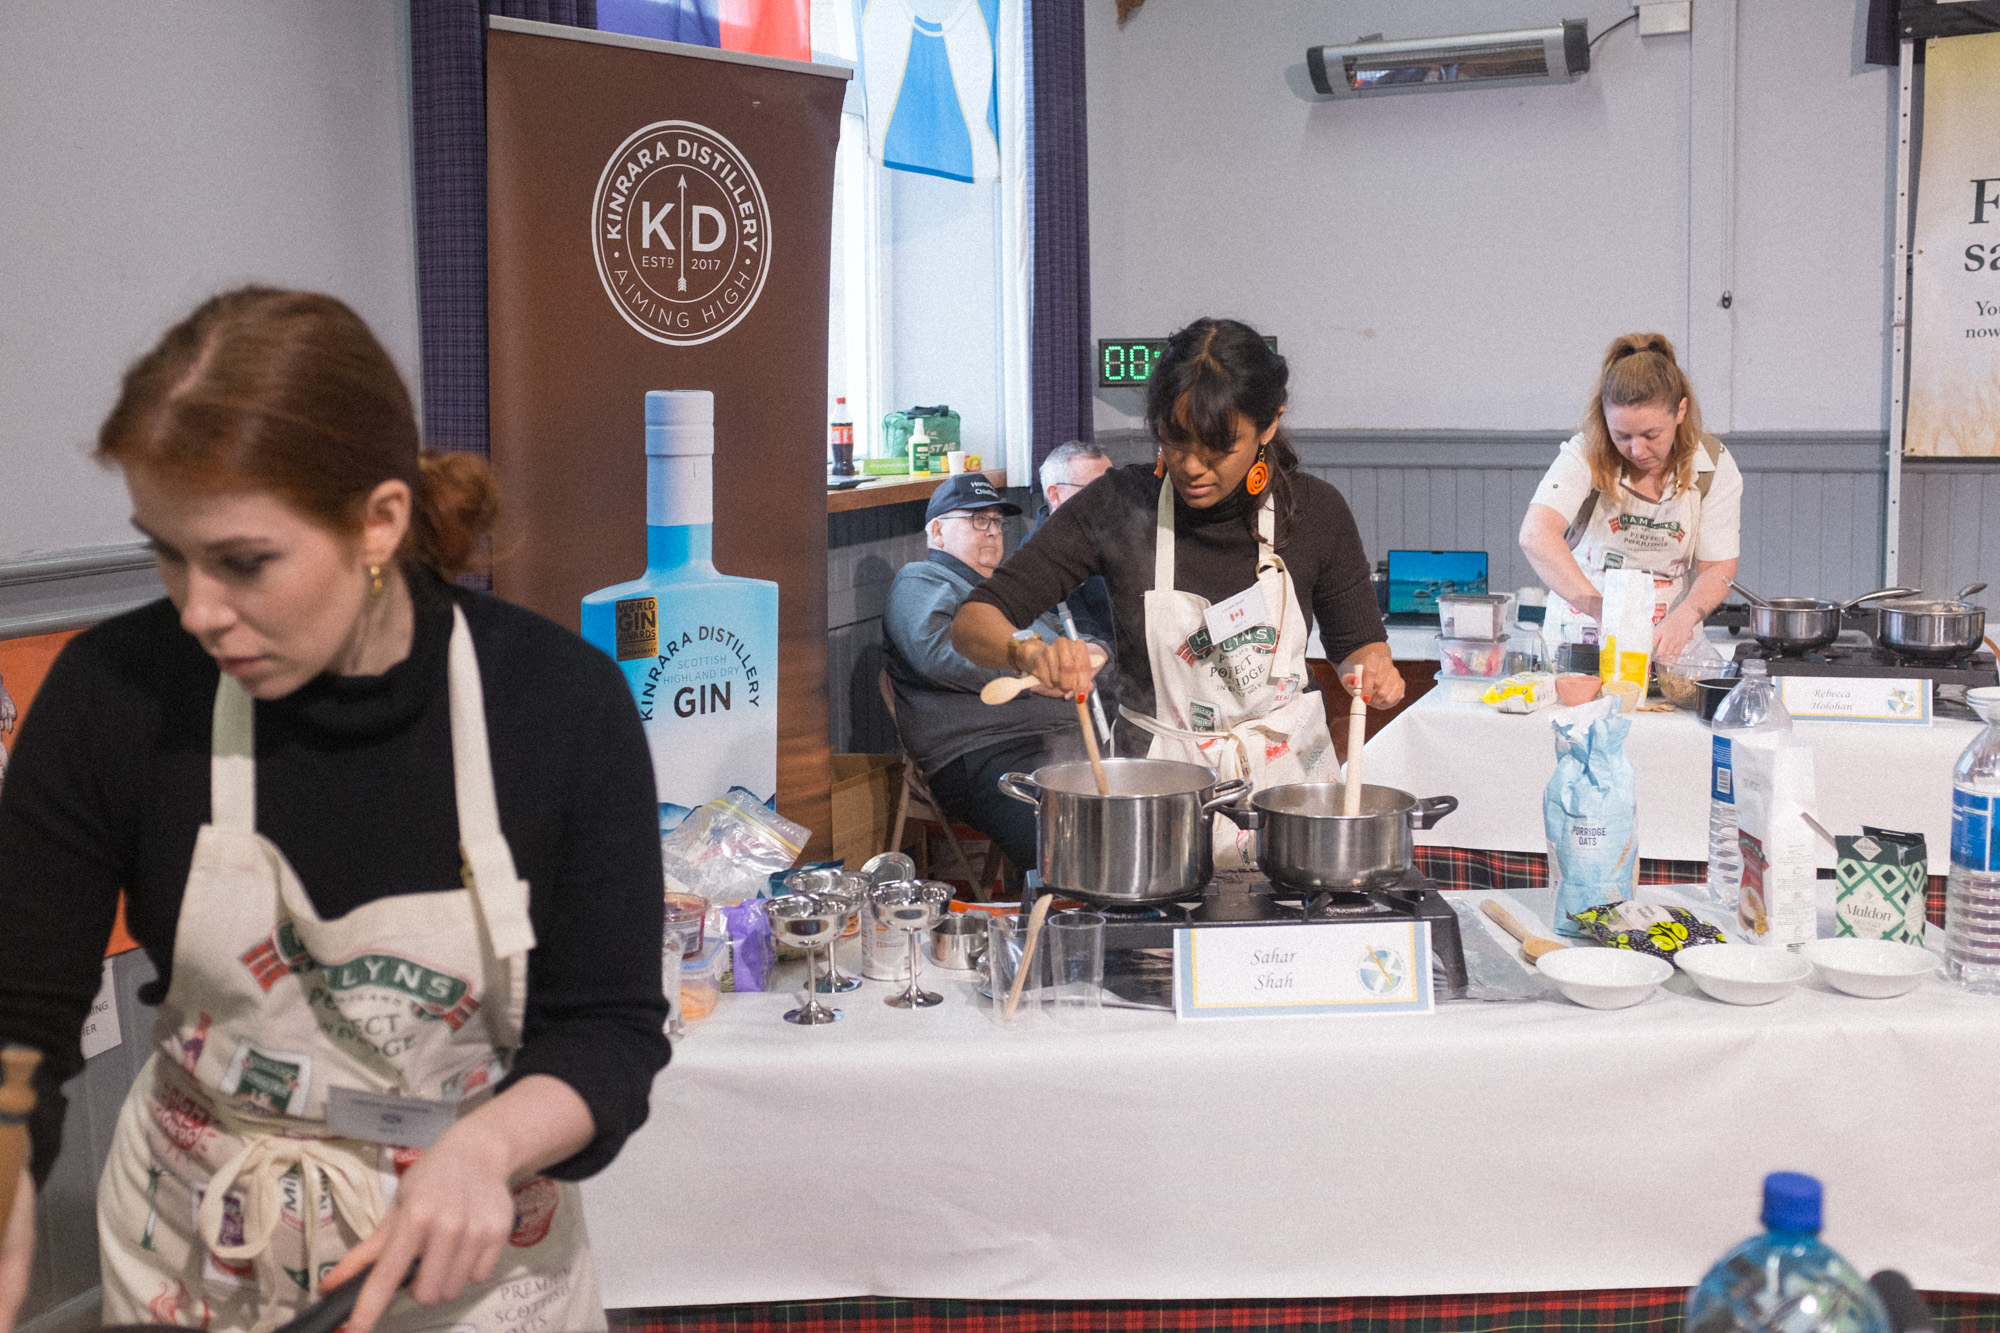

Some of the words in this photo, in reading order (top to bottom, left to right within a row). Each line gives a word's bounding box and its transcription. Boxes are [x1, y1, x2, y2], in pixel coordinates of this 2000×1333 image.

[606, 141, 671, 240] KINRARA
[677, 138, 758, 253] DISTILLERY
[691, 258, 721, 271] 2017
[614, 269, 690, 328] AIMING
[701, 270, 751, 323] HIGH
[1975, 301, 2000, 316] Yo
[619, 610, 656, 632] GIN
[677, 654, 727, 670] SCOTTISH
[640, 631, 692, 722] KINRARA
[699, 625, 760, 708] DISTILLERY
[663, 669, 717, 685] HIGHLAND
[720, 665, 740, 677] DRY
[674, 681, 731, 718] GIN
[1814, 688, 1852, 699] Rebecca
[1572, 825, 1607, 837] PORRIDGE
[1578, 836, 1597, 847] OATS
[1846, 903, 1892, 922] Maldon
[1250, 947, 1298, 966] Sahar
[1254, 972, 1294, 991] Shah
